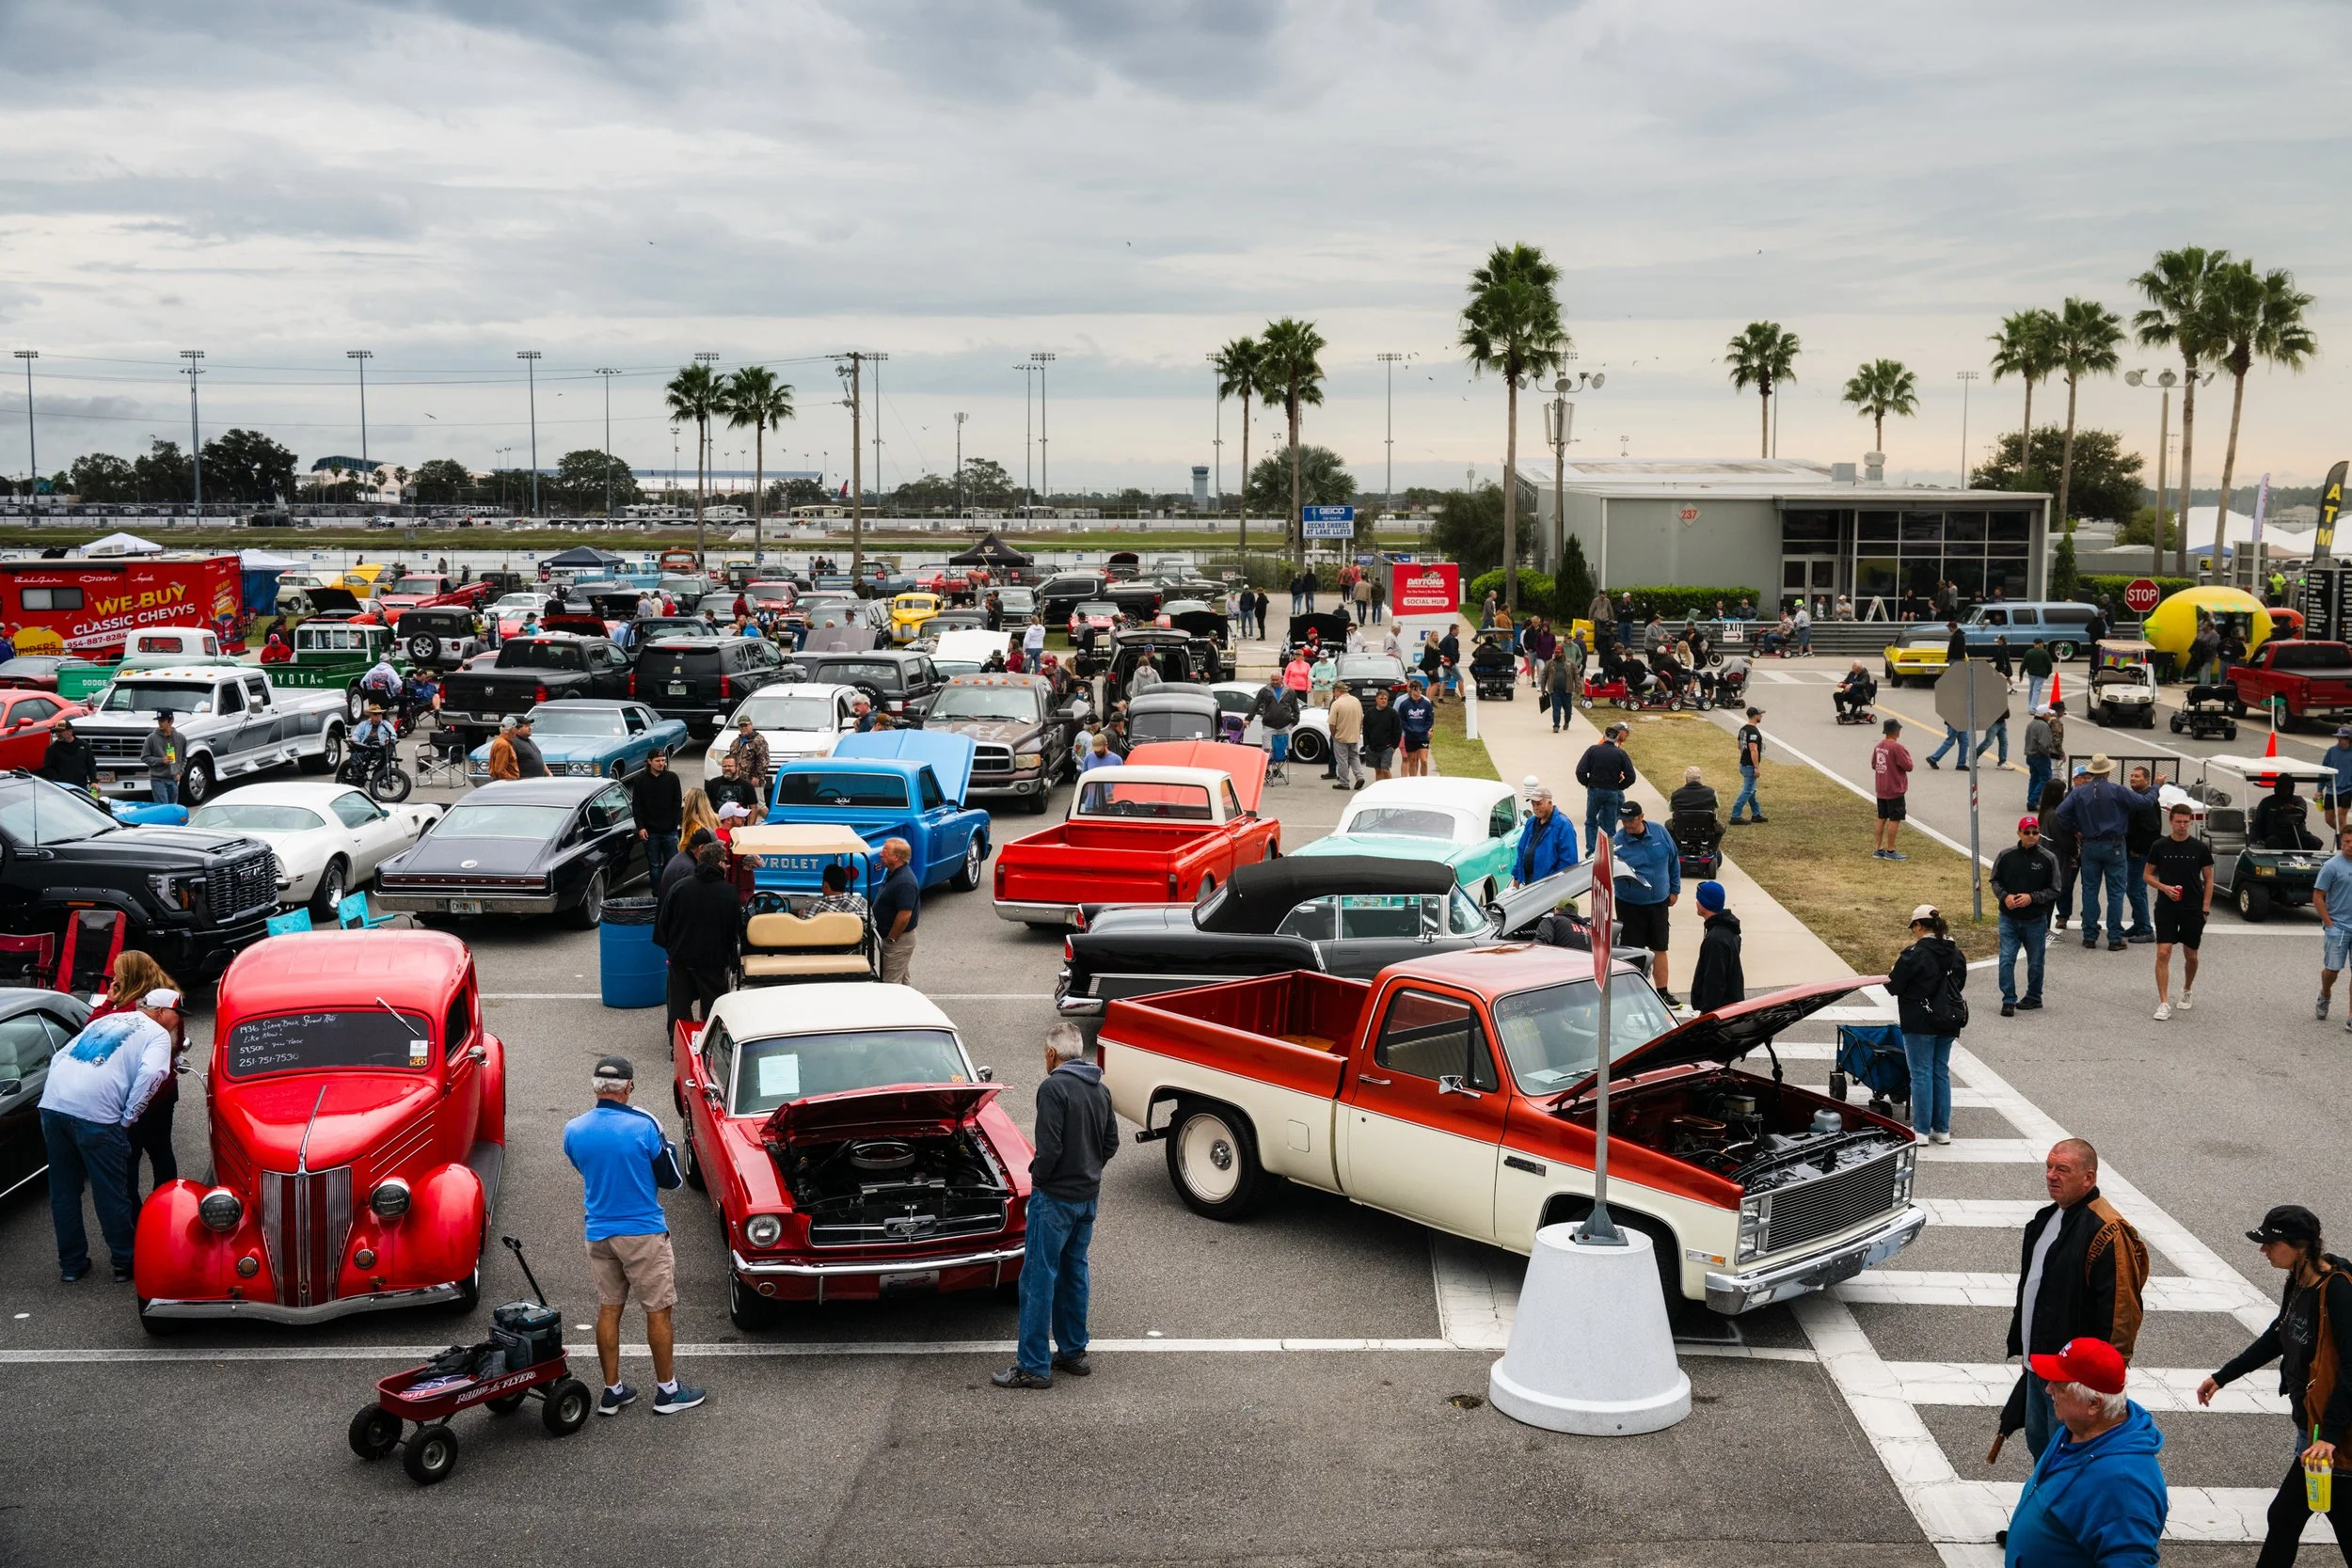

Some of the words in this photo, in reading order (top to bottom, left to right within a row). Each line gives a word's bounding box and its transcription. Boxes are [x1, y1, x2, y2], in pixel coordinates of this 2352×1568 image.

[1680, 510, 1697, 519] 237
[2317, 483, 2341, 546] ATM
[96, 594, 134, 617] WE
[140, 585, 187, 609] BUY
[2127, 589, 2157, 602] STOP
[72, 614, 134, 636] CLASSIC
[137, 603, 196, 624] CHEVYS
[1724, 623, 1742, 632] EXIT
[67, 632, 127, 649] 954-887-8284
[268, 673, 316, 685] OYOTA
[857, 686, 876, 695] ORD
[759, 858, 818, 870] VROLET
[1592, 875, 1610, 942] STOP
[240, 1025, 260, 1034] 1936
[244, 1035, 261, 1043] Like
[239, 1053, 299, 1067] 251-751-7530
[455, 1386, 490, 1404] RADIO
[499, 1371, 536, 1388] FLYER
